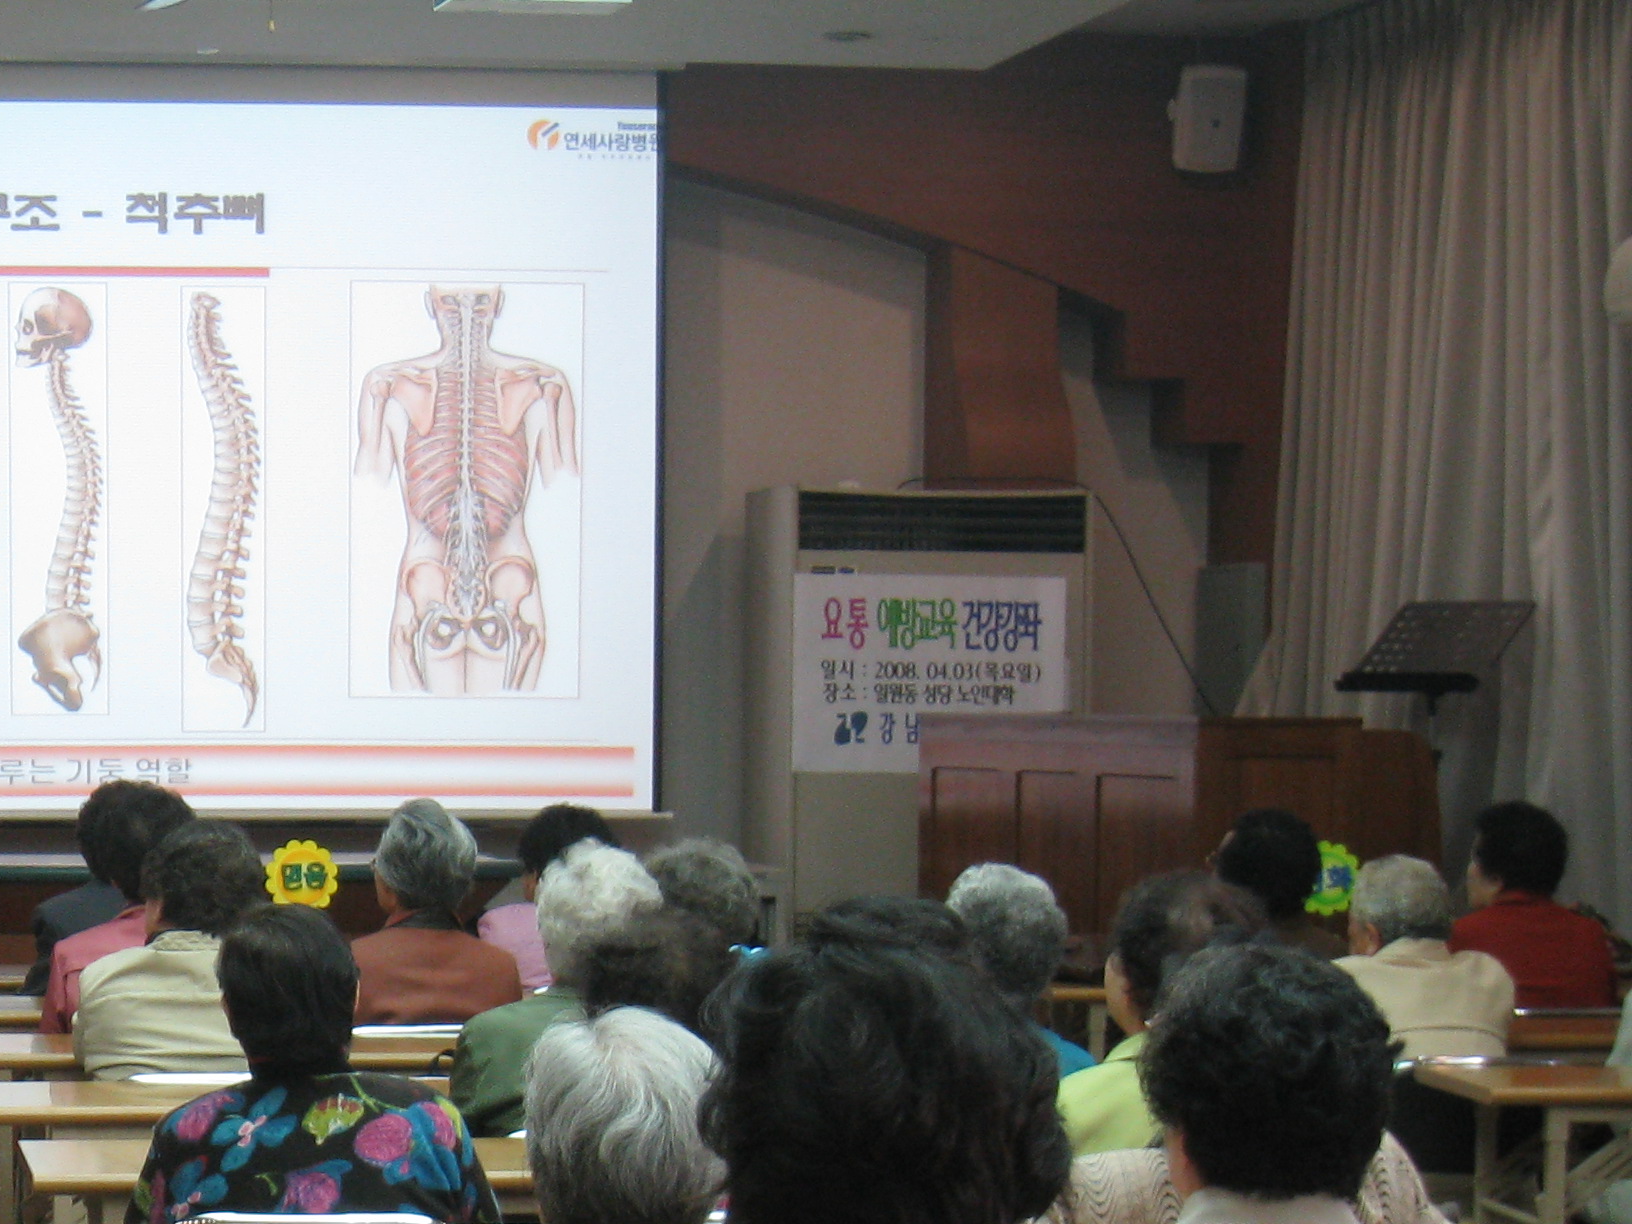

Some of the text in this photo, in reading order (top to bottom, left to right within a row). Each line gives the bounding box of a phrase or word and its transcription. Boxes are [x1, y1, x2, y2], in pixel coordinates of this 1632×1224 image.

[126, 192, 265, 235] 척추뼈
[877, 598, 957, 650] 예방교육
[962, 600, 1042, 651] 건강강좌
[821, 659, 854, 681] 일시
[823, 682, 856, 704] 장소
[136, 758, 193, 785] 역할
